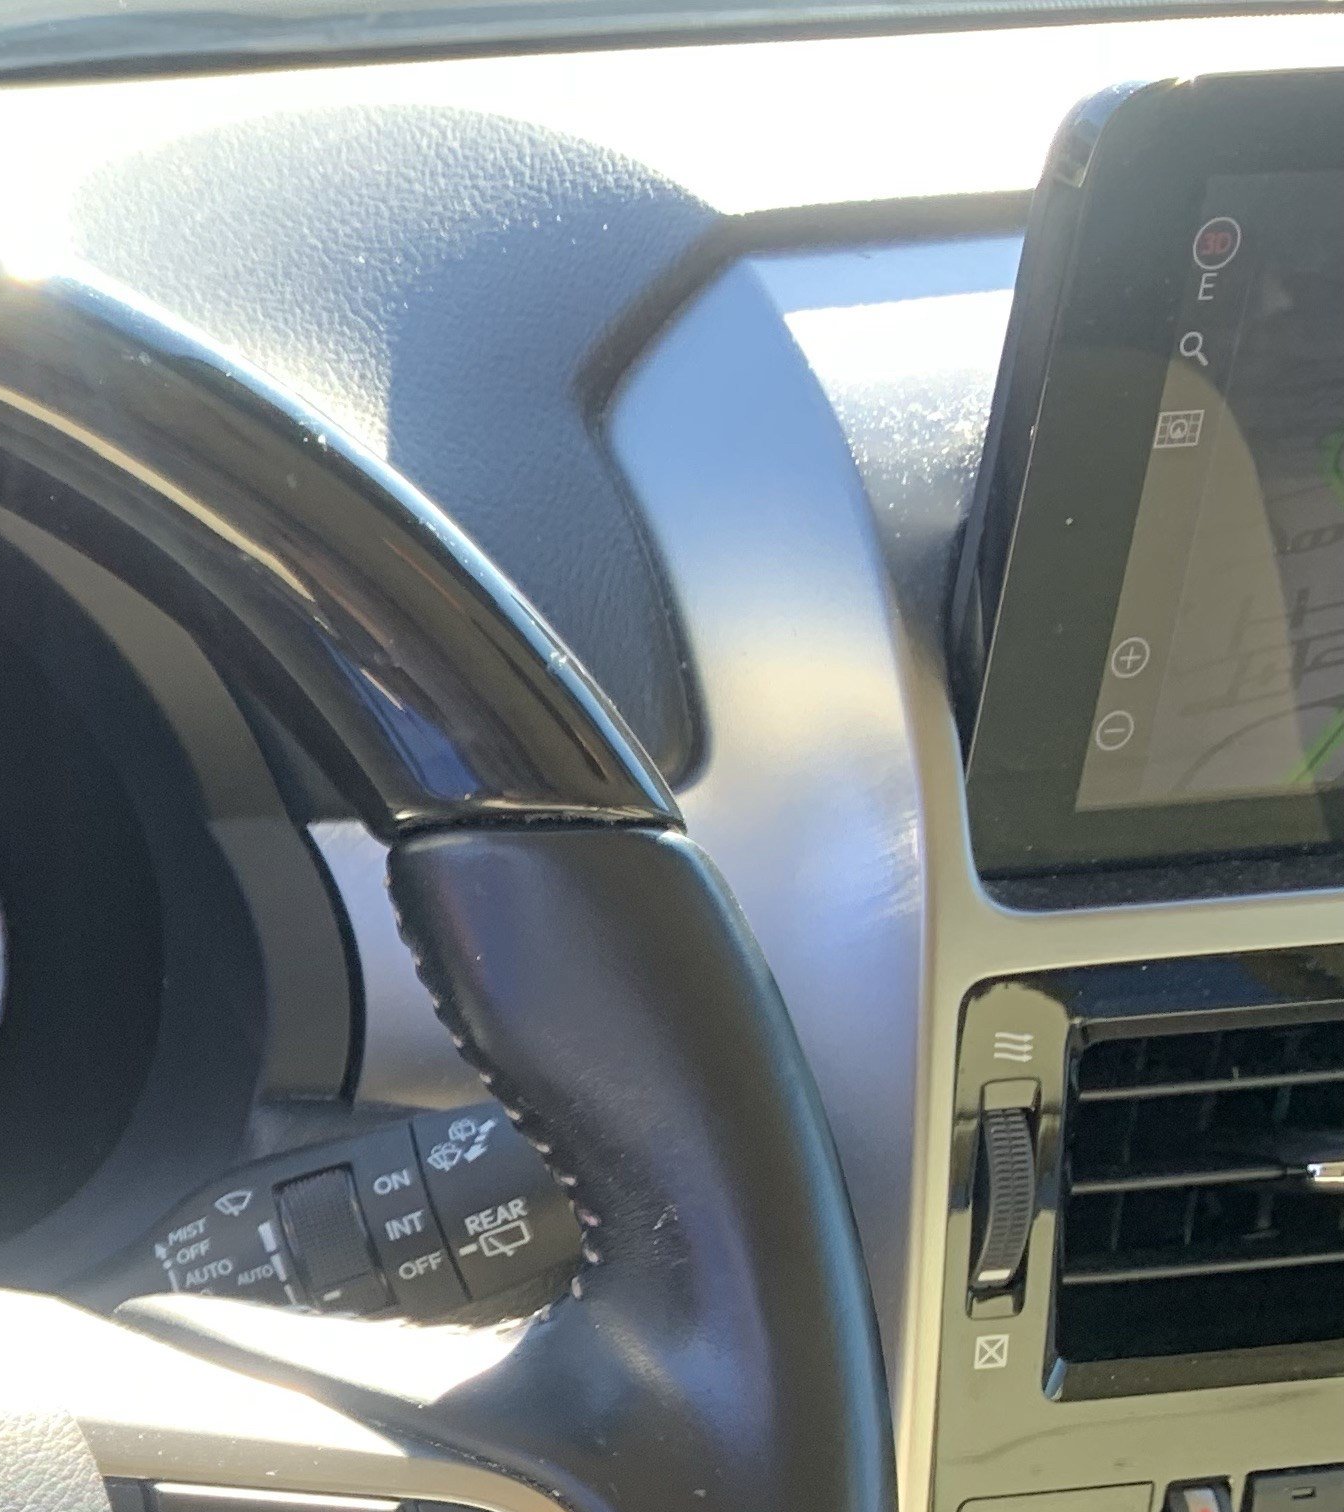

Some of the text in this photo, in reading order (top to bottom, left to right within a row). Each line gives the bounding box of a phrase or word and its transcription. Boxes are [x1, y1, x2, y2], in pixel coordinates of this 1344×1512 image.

[1198, 272, 1219, 300] E
[373, 1168, 411, 1196] ON
[167, 1214, 209, 1246] MIST
[384, 1208, 425, 1243] INT
[463, 1197, 529, 1237] REAR
[175, 1236, 212, 1265] OFF
[398, 1250, 443, 1280] OFF
[184, 1256, 234, 1289] AUTO
[237, 1262, 274, 1287] AUTO
